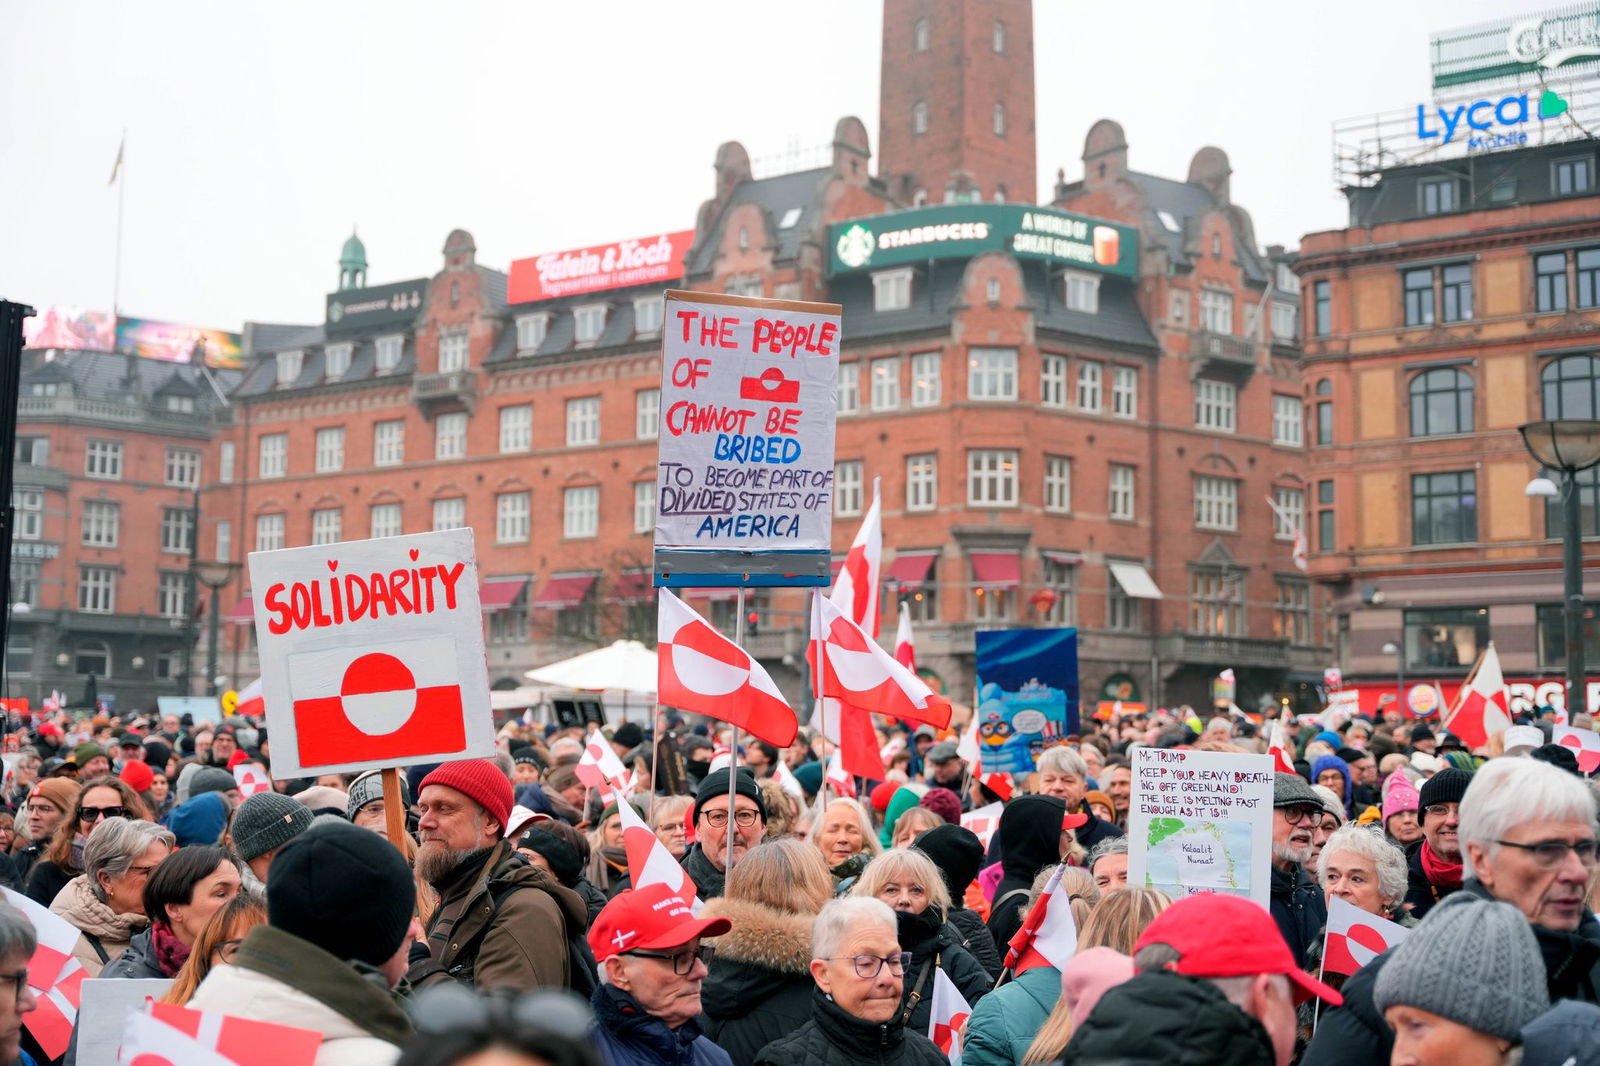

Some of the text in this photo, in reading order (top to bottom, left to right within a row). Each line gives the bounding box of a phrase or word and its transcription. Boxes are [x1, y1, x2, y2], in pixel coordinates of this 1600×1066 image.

[1417, 93, 1528, 144] Lyca
[1467, 131, 1528, 151] Mobile
[1022, 211, 1033, 231] A
[878, 222, 988, 249] STARBUCKS
[601, 246, 616, 272] &
[616, 235, 672, 270] Koch
[677, 311, 838, 359] THE PEOPLE
[671, 357, 712, 390] OF
[666, 401, 803, 436] CANNOT BE
[714, 433, 801, 464] BRIBED
[660, 462, 833, 489] TO BECOME PART OF
[738, 491, 801, 512] STATES
[803, 492, 829, 511] OF
[696, 514, 800, 538] AMERICA
[1155, 750, 1186, 763] TRUMP
[1139, 766, 1167, 779] KEEP
[1170, 768, 1195, 781] YOUR
[1199, 770, 1231, 782] HEAVY
[1159, 781, 1177, 792] OFF
[1181, 782, 1243, 794] GREENLAND!
[1140, 794, 1160, 803] THE
[1195, 796, 1232, 807] MELTING
[1236, 797, 1260, 808] FAST
[1140, 804, 1176, 816] ENOUGH
[1179, 806, 1193, 817] AS
